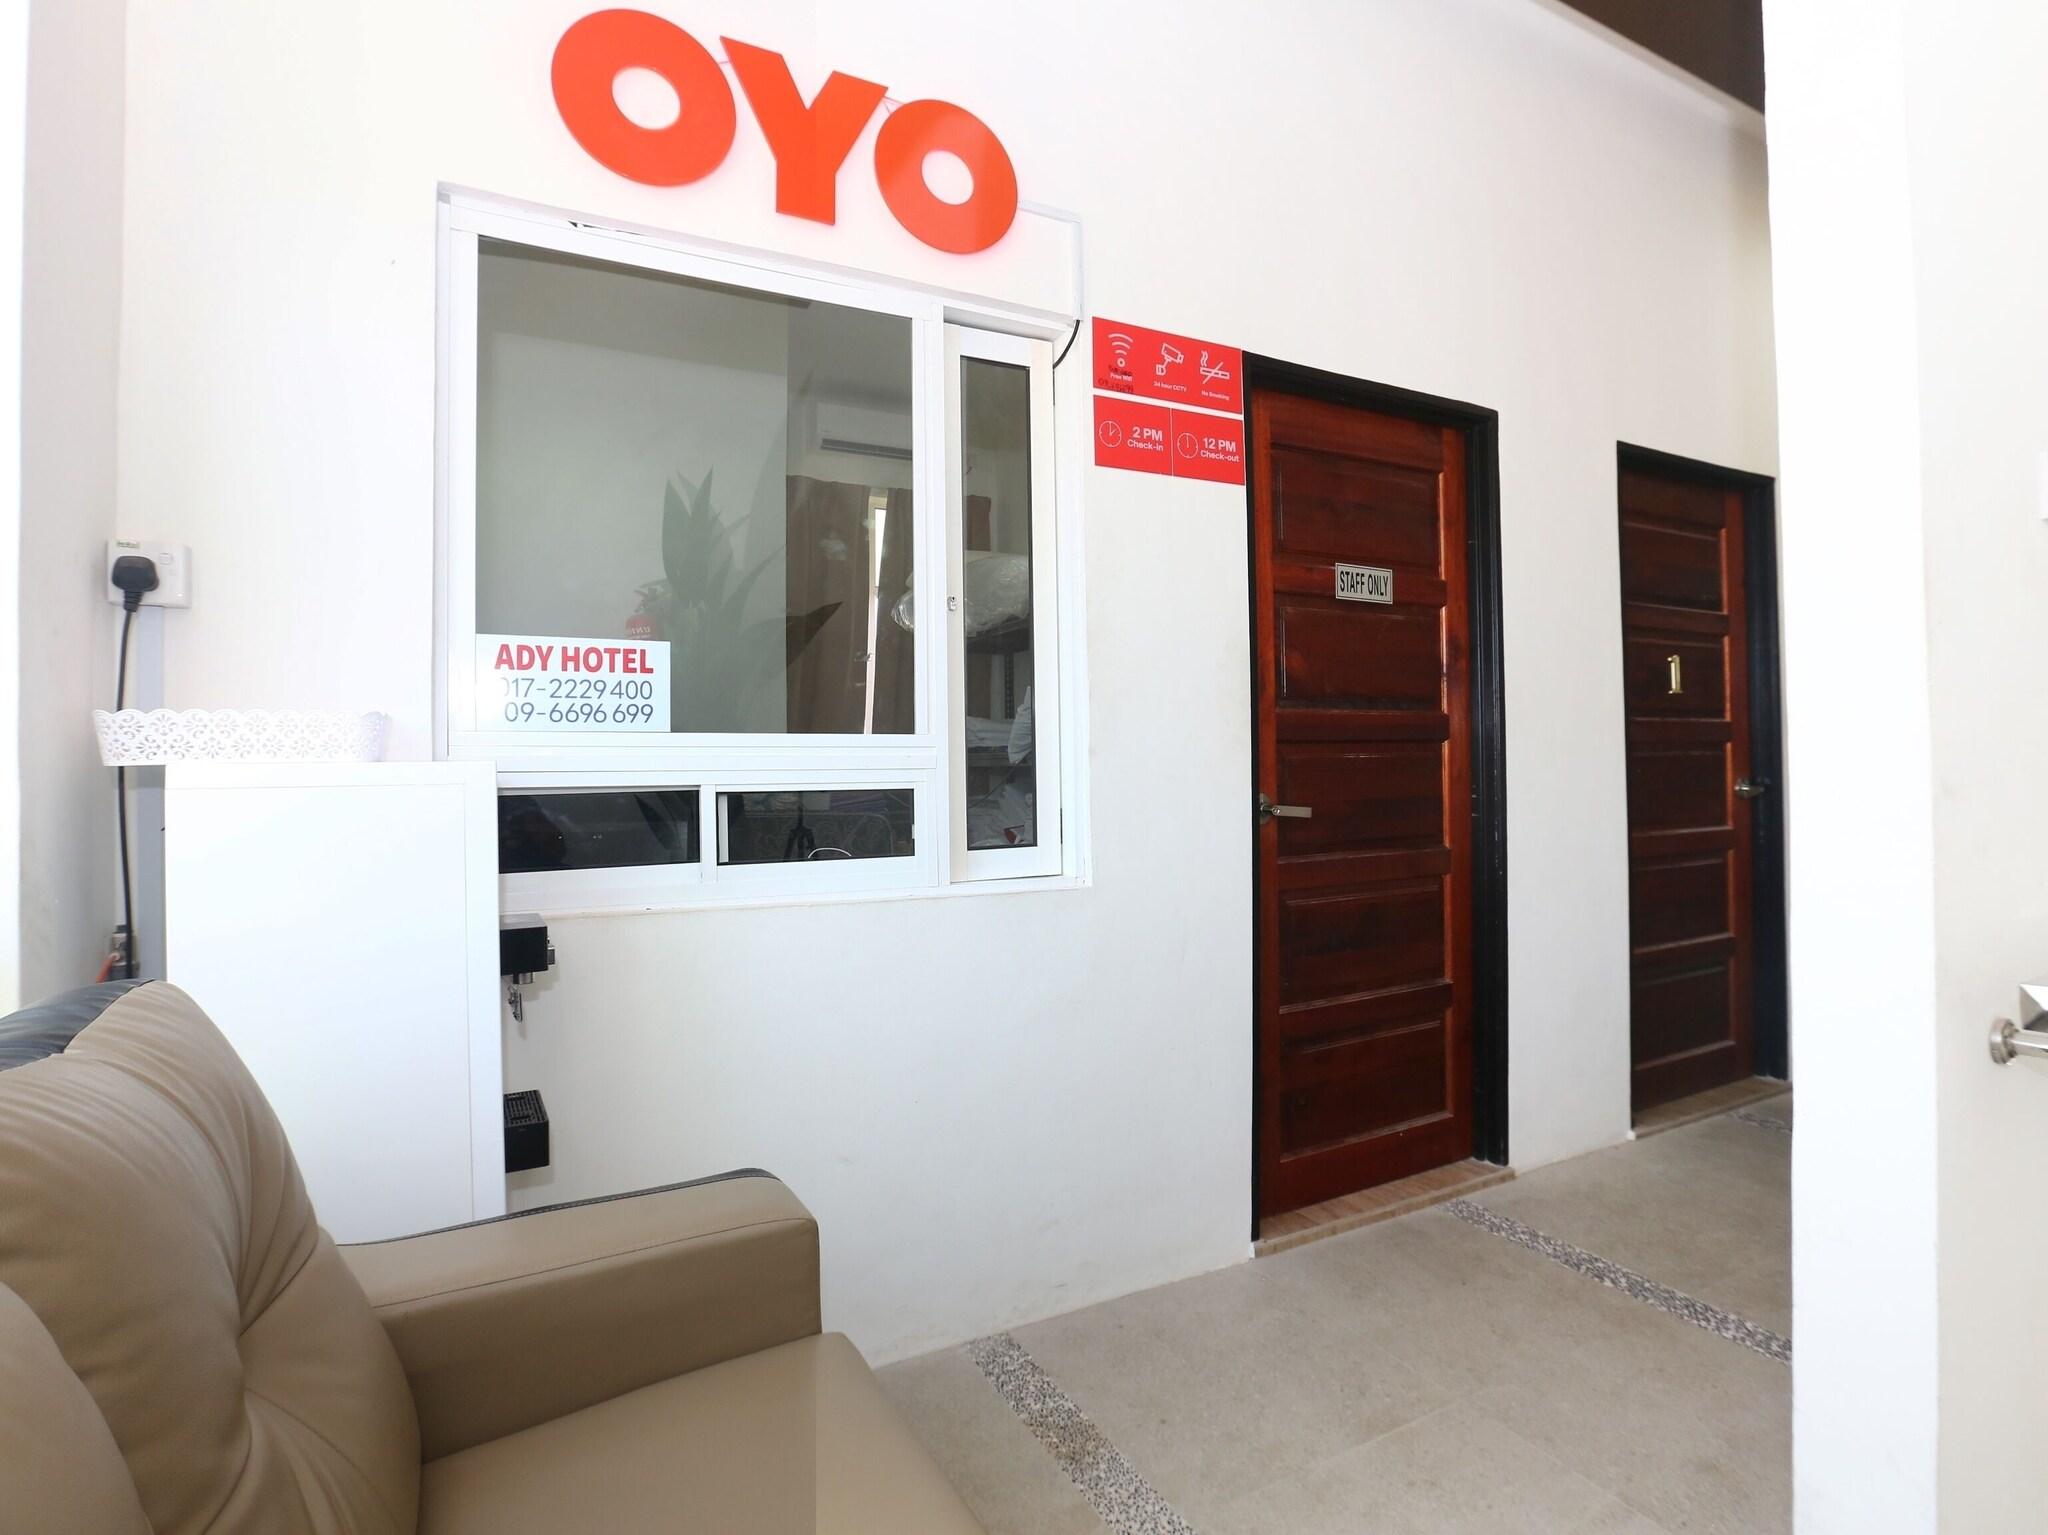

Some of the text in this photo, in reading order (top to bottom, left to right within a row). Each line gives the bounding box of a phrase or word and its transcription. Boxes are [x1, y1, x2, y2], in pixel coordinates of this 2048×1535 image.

[551, 9, 1018, 254] OYO
[1132, 426, 1163, 441] 2 PM
[1127, 439, 1164, 451] Check-in
[1203, 438, 1236, 452] 12 PM
[1200, 449, 1240, 462] Check-out
[1339, 570, 1389, 596] STAFF ONLY
[494, 643, 654, 674] ADY HOTEL
[1667, 654, 1684, 694] 1
